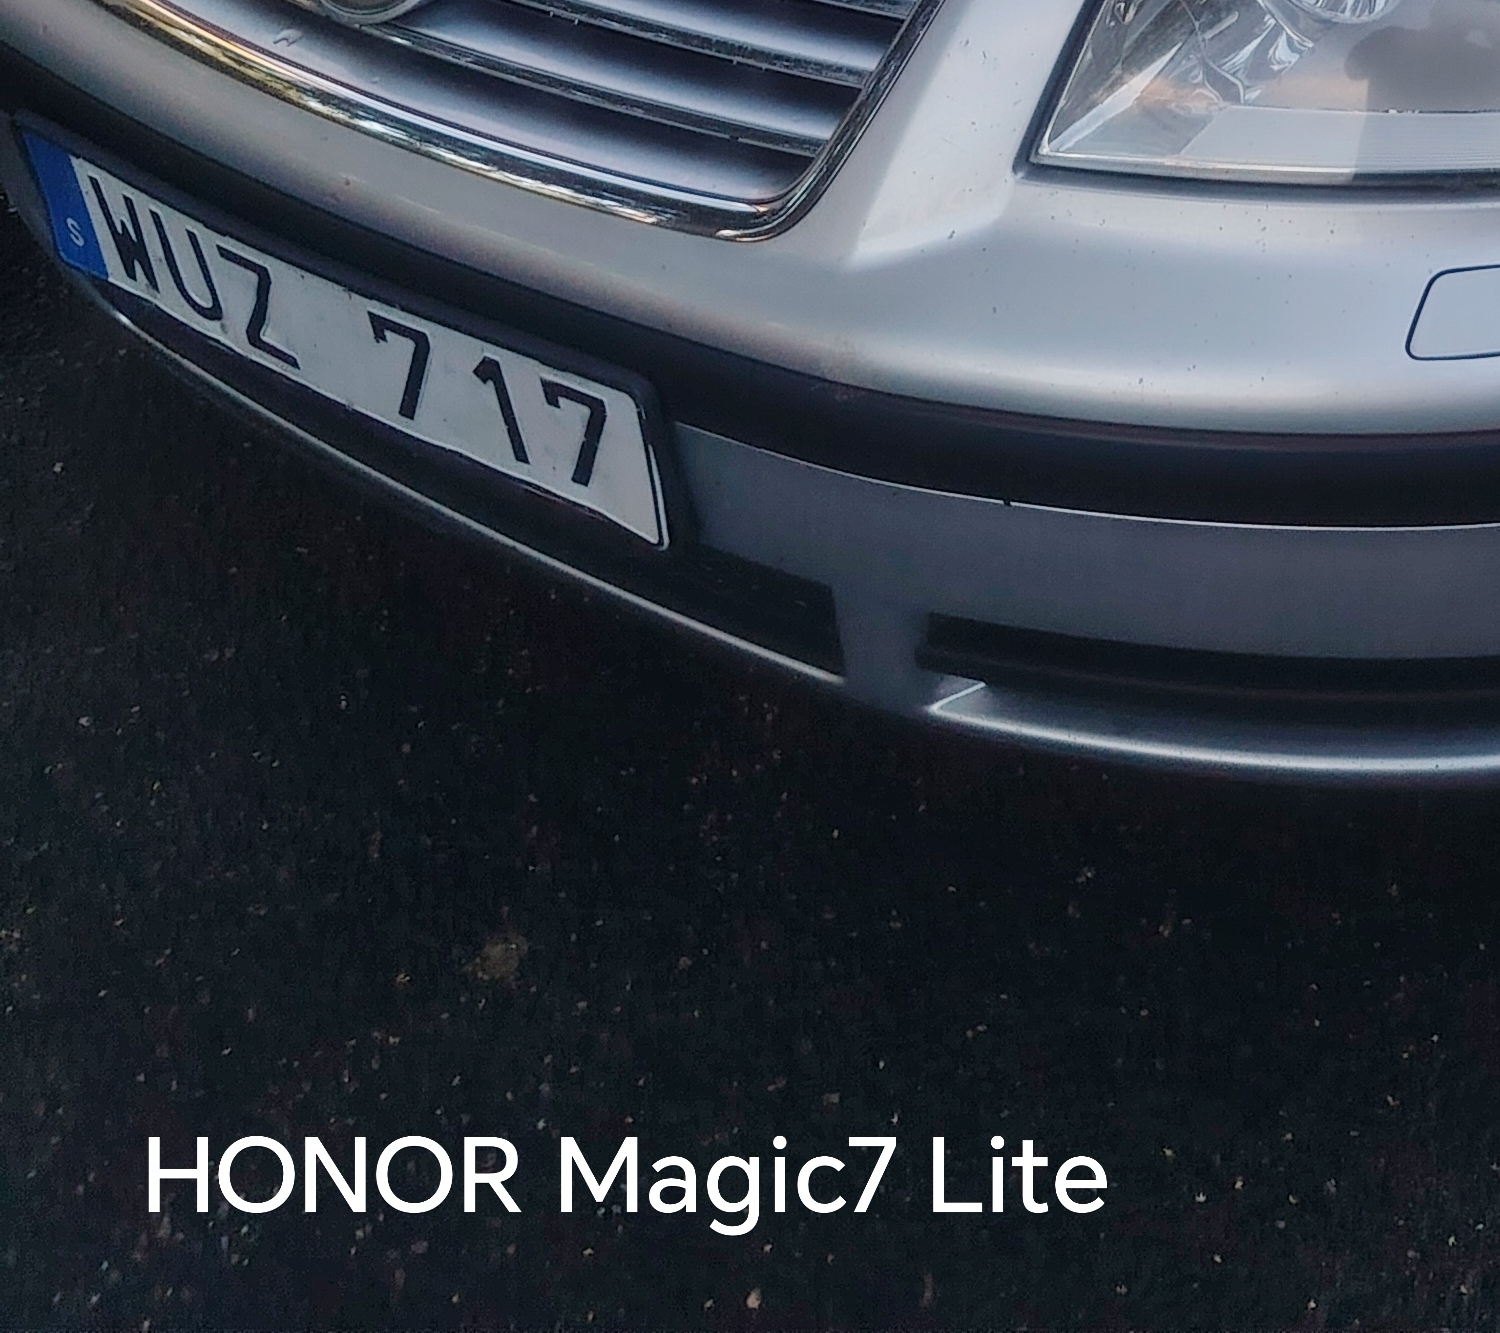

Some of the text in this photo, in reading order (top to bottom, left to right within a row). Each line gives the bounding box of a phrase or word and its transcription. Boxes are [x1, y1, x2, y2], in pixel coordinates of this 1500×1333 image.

[65, 217, 85, 247] S
[88, 175, 608, 487] WUZ 717
